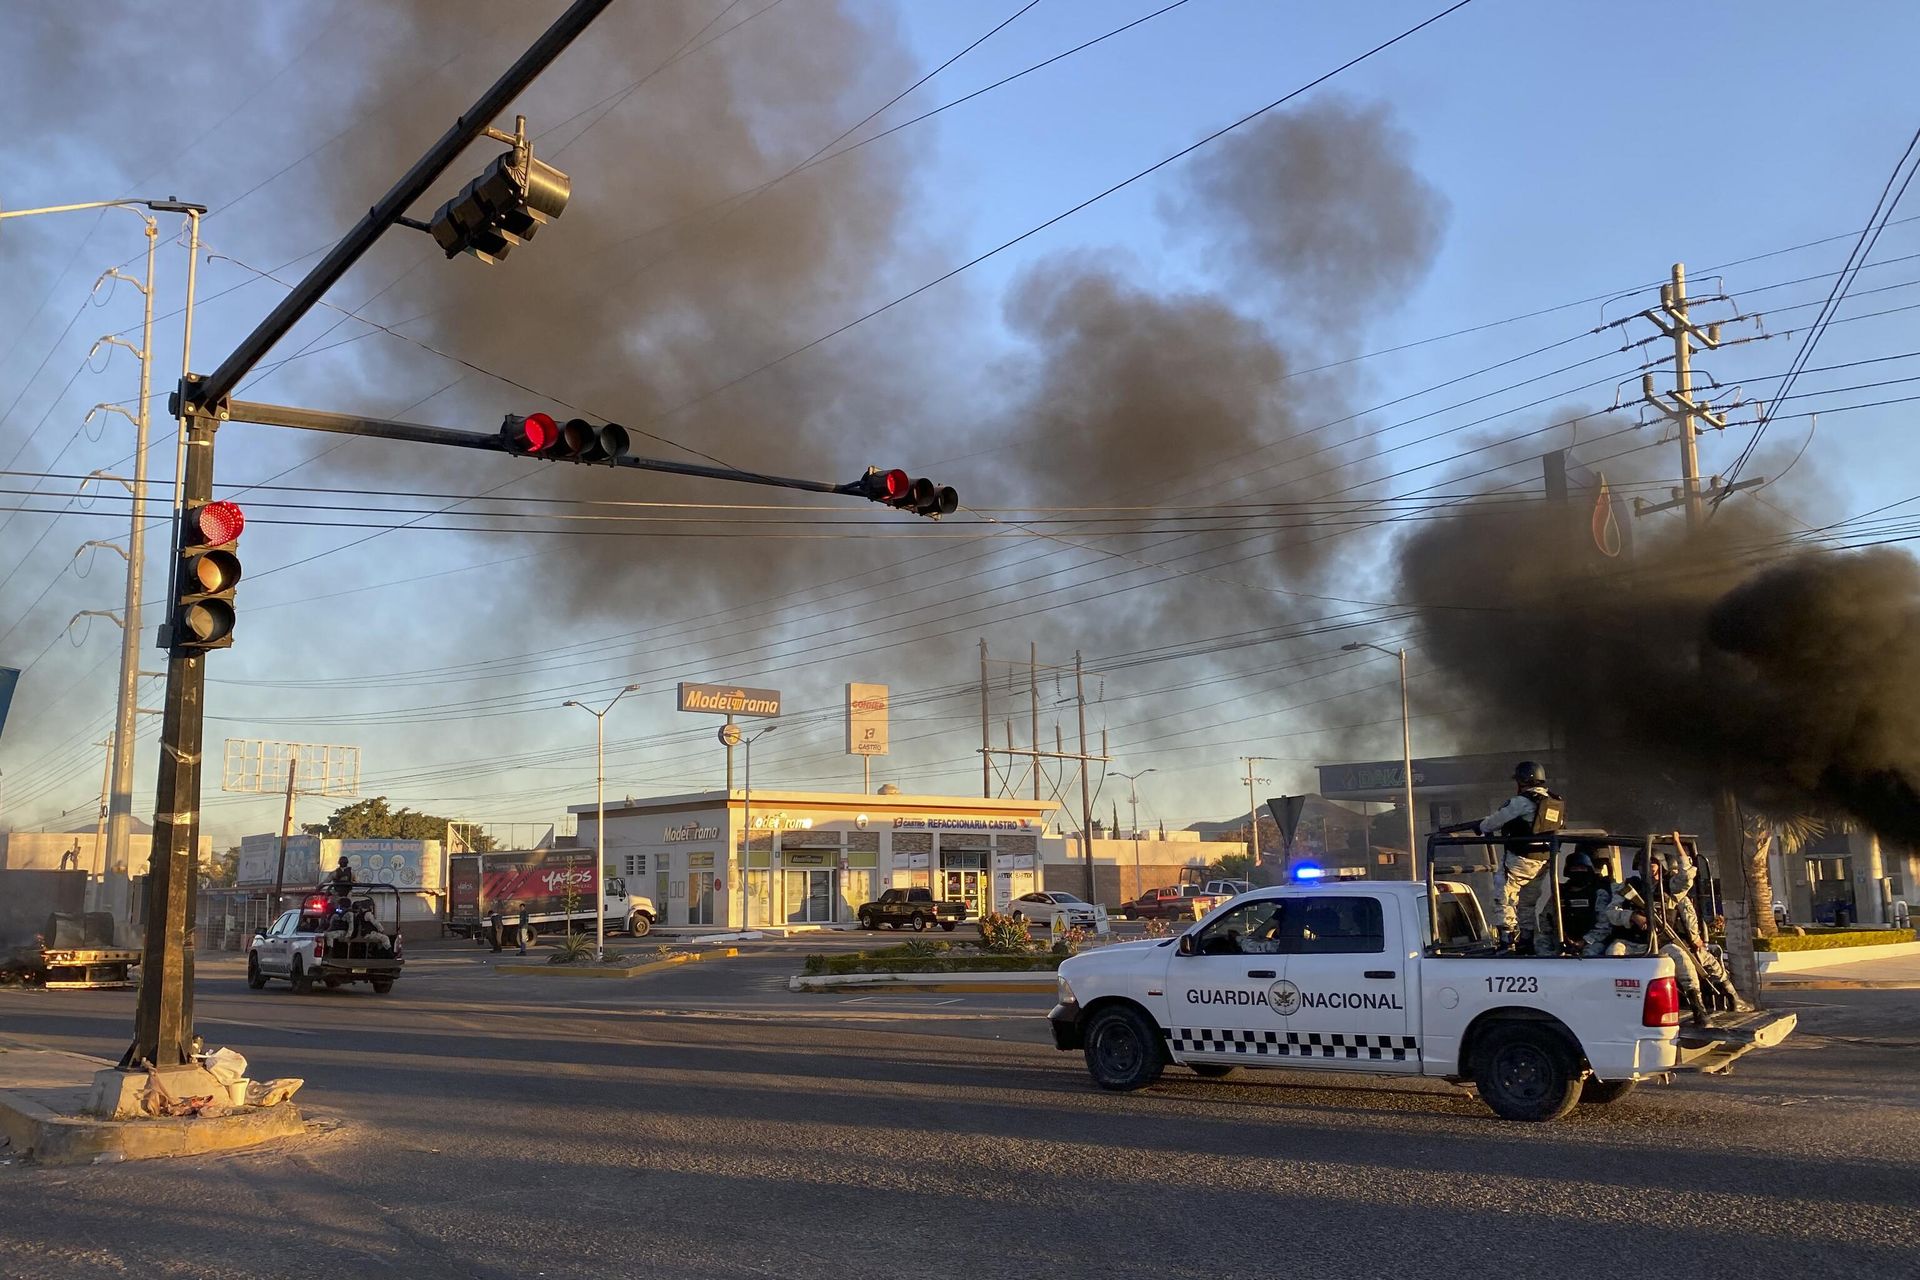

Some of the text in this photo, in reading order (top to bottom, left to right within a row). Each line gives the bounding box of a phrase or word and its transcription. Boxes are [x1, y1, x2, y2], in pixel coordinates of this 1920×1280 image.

[858, 743, 881, 751] CASTRO
[928, 818, 1018, 830] REFACCIONARIA CASTRO
[1485, 976, 1538, 993] 17223
[1186, 989, 1403, 1010] GUARDIA NACIONAL
